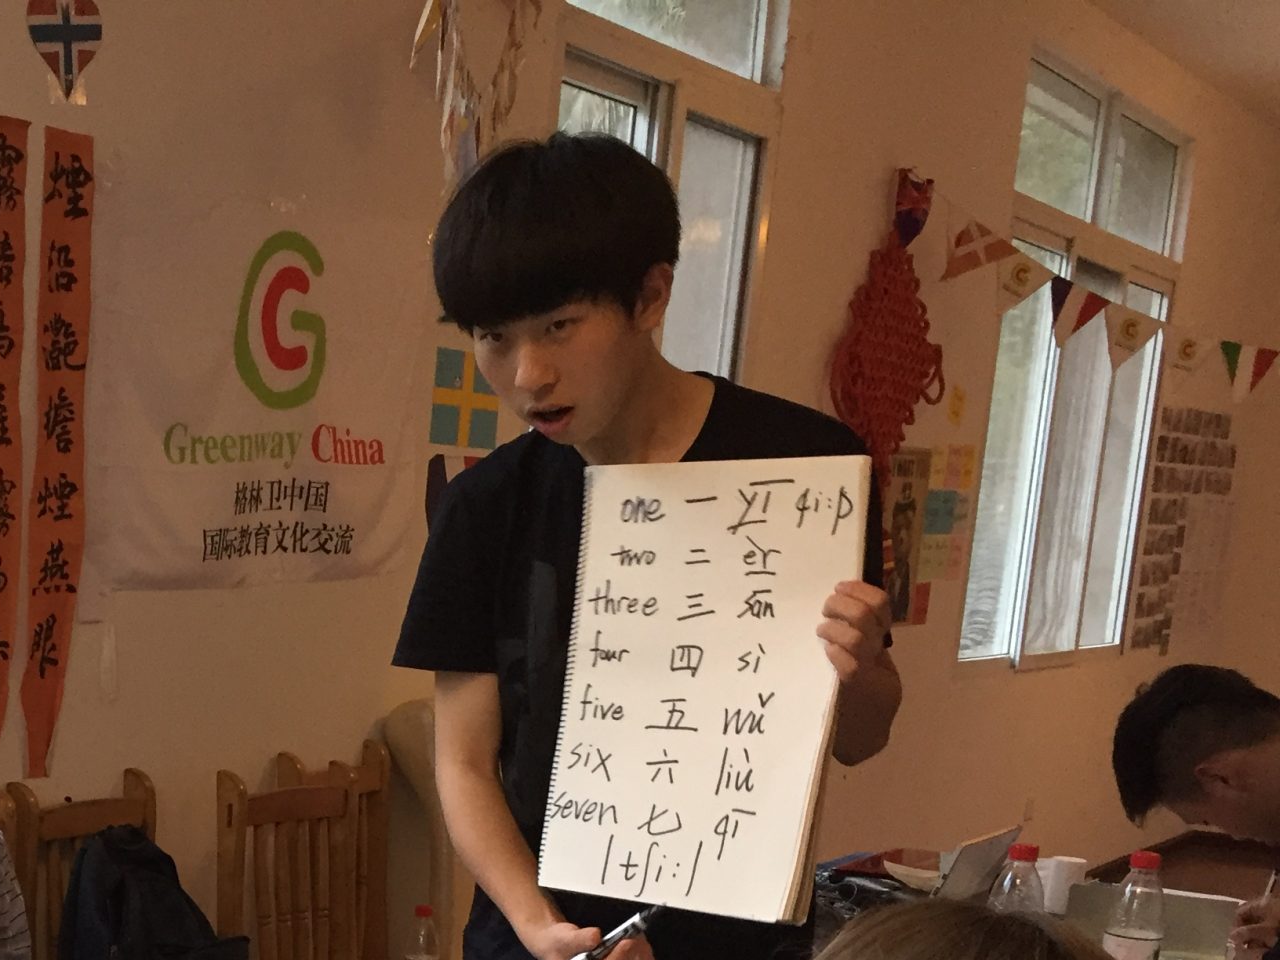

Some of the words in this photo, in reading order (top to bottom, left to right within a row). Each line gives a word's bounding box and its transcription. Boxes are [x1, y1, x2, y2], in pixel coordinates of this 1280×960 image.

[163, 421, 303, 470] Greenway
[311, 423, 385, 466] China
[234, 477, 330, 516] 格林卫中国
[621, 496, 665, 523] one
[202, 520, 355, 563] 国际教育文化交流
[611, 545, 656, 566] two
[684, 549, 711, 564] 二
[588, 580, 658, 616] three
[676, 593, 716, 621] 三
[589, 630, 630, 668] four
[670, 644, 704, 678] 四
[580, 683, 625, 721] five
[644, 697, 699, 732] 五
[567, 742, 613, 782] six
[646, 748, 679, 784] 六
[549, 791, 618, 826] seven
[637, 803, 682, 836] 七
